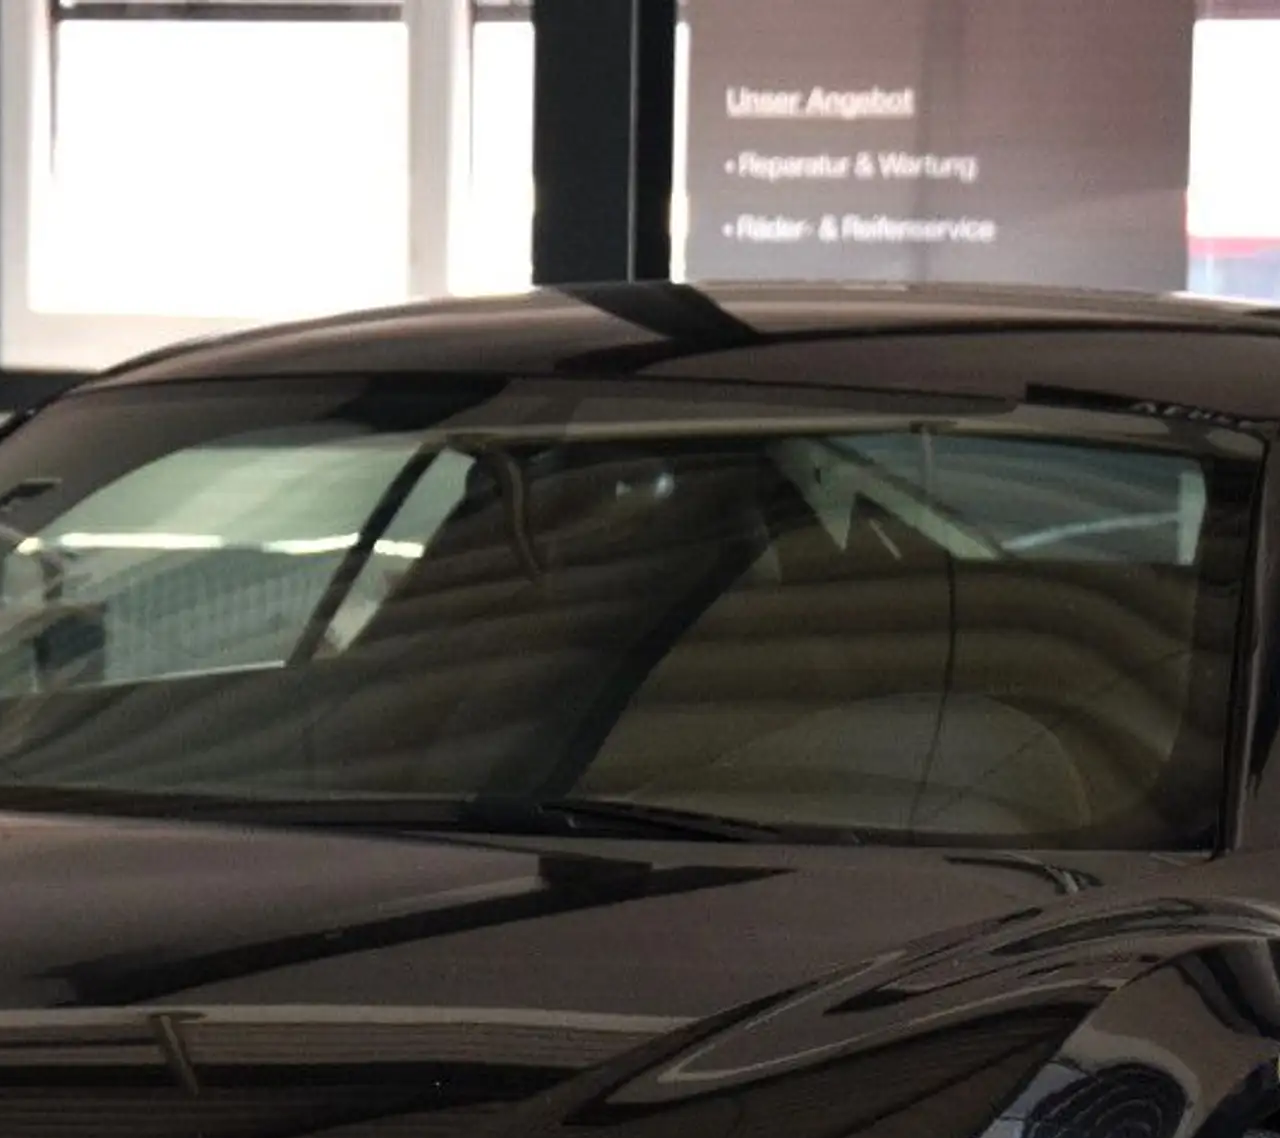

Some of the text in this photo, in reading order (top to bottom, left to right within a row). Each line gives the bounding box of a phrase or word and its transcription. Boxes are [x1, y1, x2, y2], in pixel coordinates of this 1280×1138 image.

[725, 84, 915, 120] Unser Angebot
[738, 151, 979, 183] Reparatur & Wartung
[817, 213, 839, 242] &
[841, 213, 997, 243] Reifenservice
